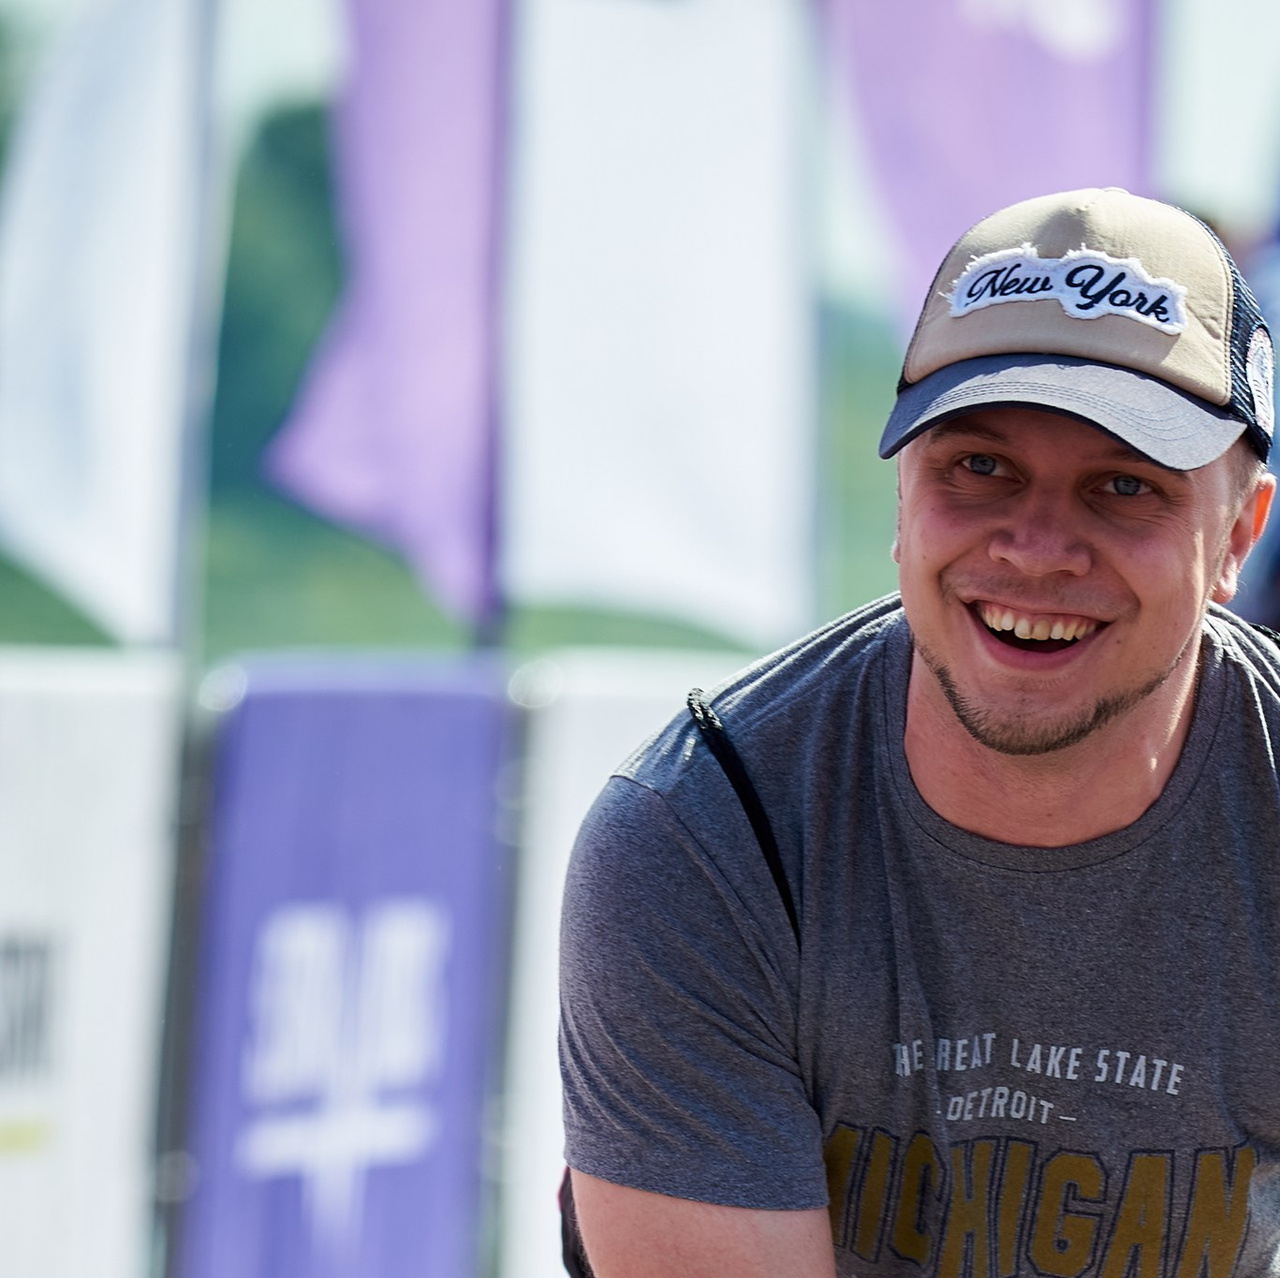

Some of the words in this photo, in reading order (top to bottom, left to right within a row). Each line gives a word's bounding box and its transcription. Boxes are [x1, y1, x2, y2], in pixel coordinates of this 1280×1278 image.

[965, 262, 1053, 306] New
[1065, 264, 1169, 323] York
[936, 1032, 997, 1071] REAT
[1010, 1038, 1083, 1081] LAKE
[1095, 1049, 1185, 1096] STATE
[946, 1086, 1055, 1125] DETROIT
